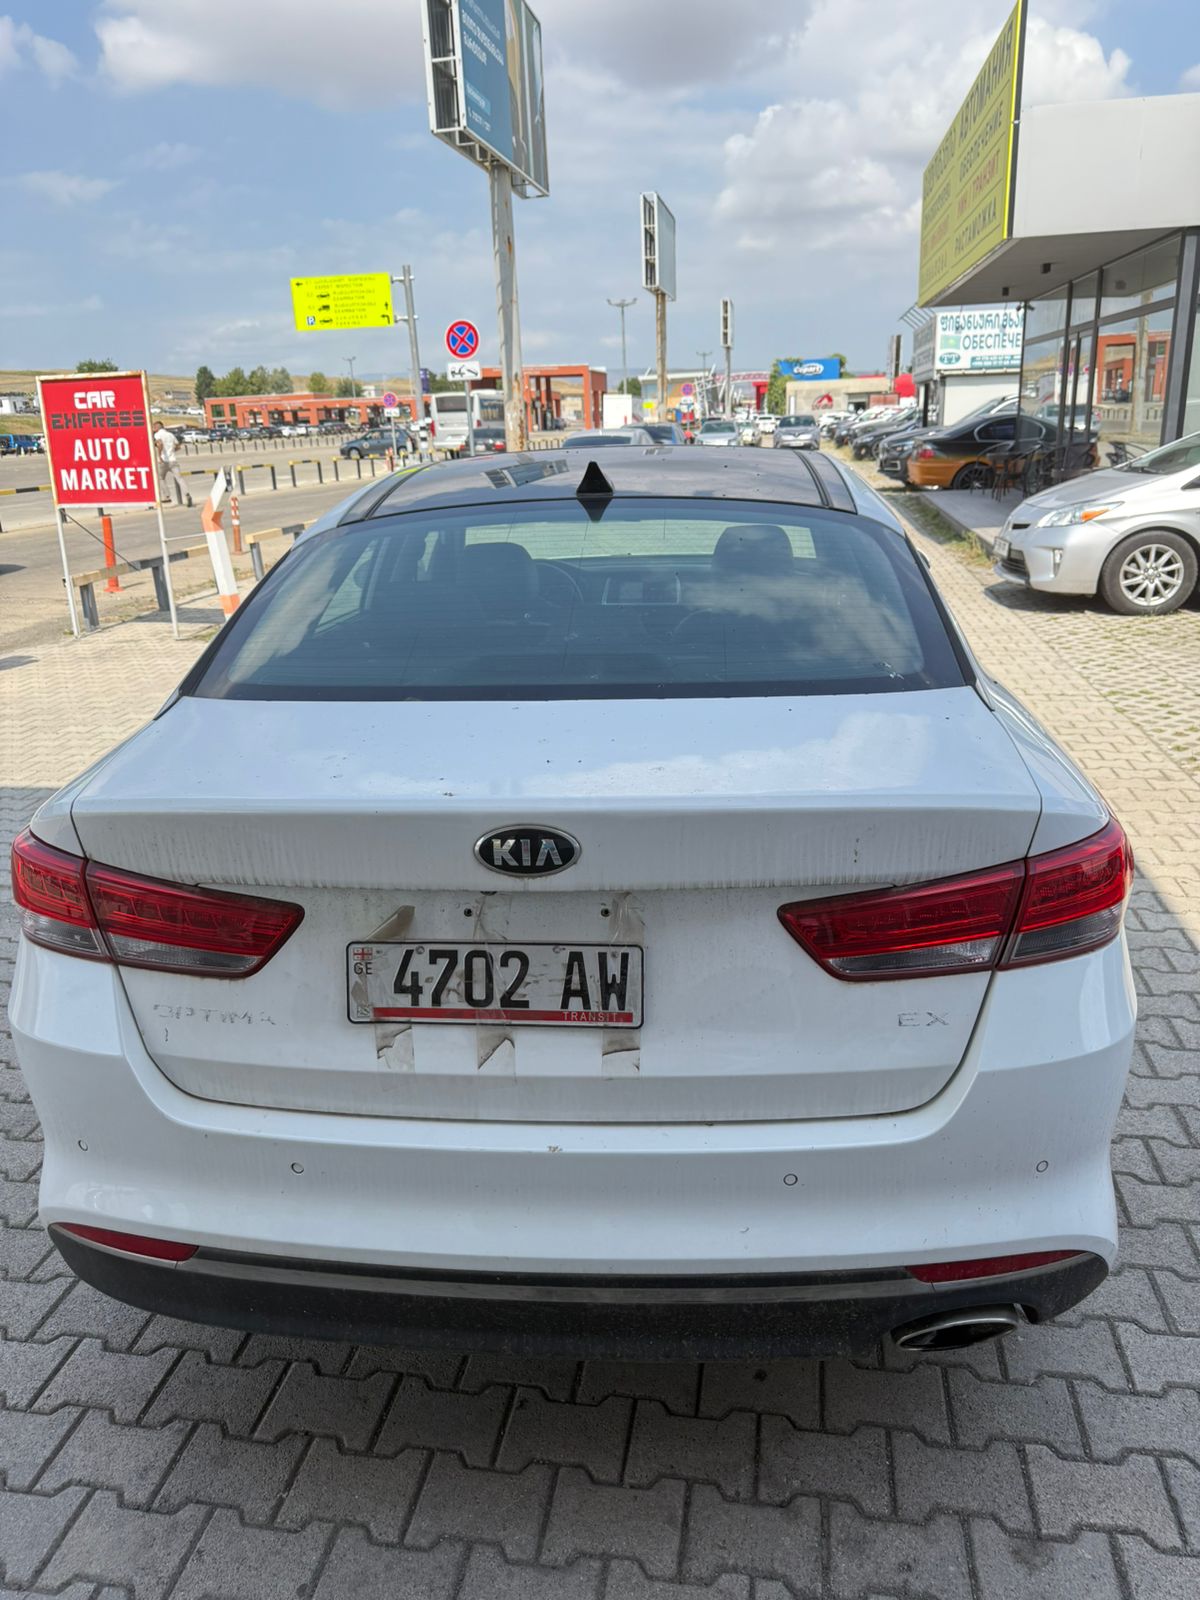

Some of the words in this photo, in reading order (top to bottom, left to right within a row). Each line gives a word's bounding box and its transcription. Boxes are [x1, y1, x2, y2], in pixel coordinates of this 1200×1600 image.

[1002, 311, 1023, 329] მხა
[962, 333, 1021, 350] ОБЕСПЕЧЕ
[74, 390, 116, 409] CAR
[51, 410, 145, 429] EXPRESS
[74, 437, 130, 461] AUTO
[60, 467, 149, 491] MARKET
[491, 838, 563, 867] KIA
[353, 962, 373, 975] GE
[393, 949, 530, 1008] 4702
[560, 951, 630, 1011] AW
[562, 1011, 618, 1022] TRANSIT
[897, 1011, 950, 1027] EX
